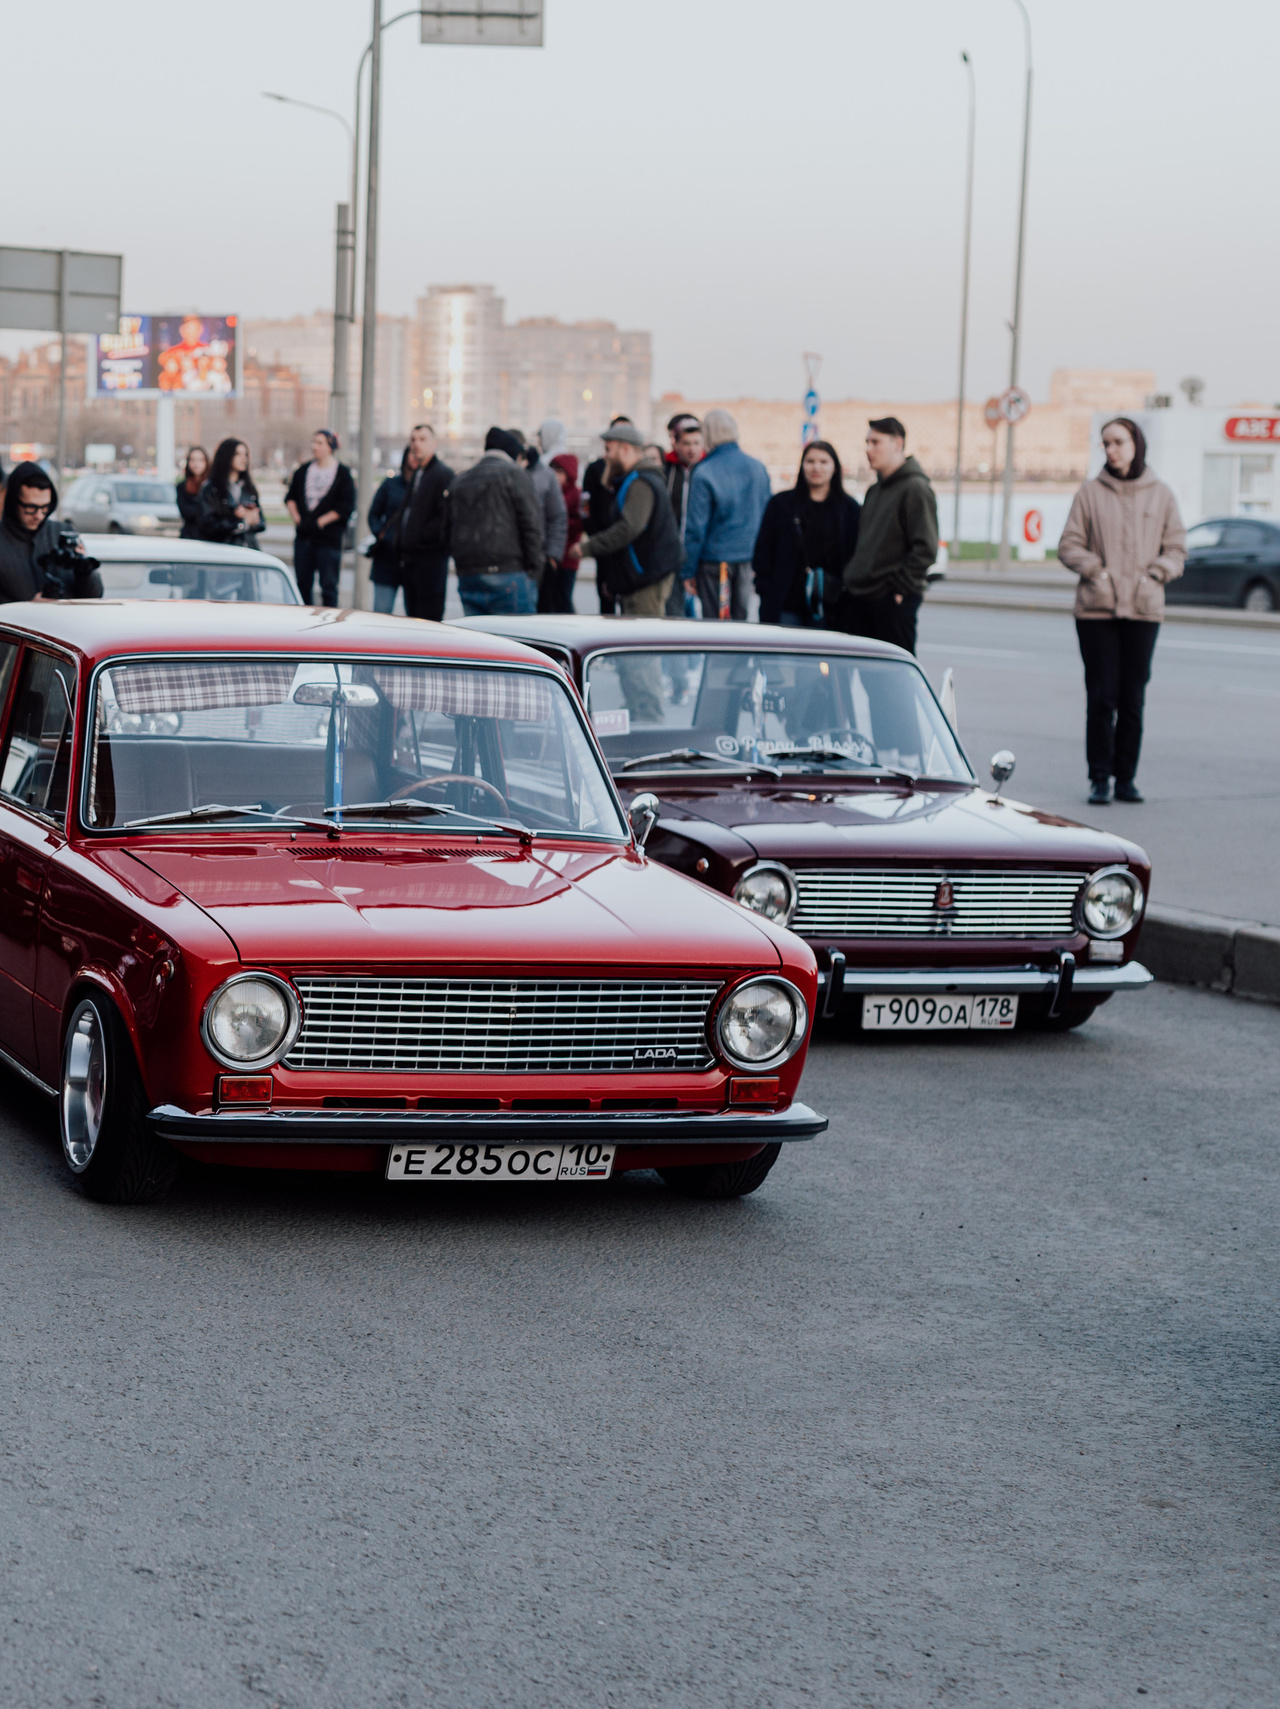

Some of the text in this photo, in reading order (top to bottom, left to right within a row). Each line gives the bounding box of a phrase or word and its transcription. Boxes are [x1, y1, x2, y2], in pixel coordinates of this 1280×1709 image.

[1234, 418, 1270, 438] АЗС
[976, 998, 1012, 1018] 178
[634, 1046, 678, 1060] LADA
[567, 1143, 604, 1167] 10
[560, 1166, 588, 1176] RUS
